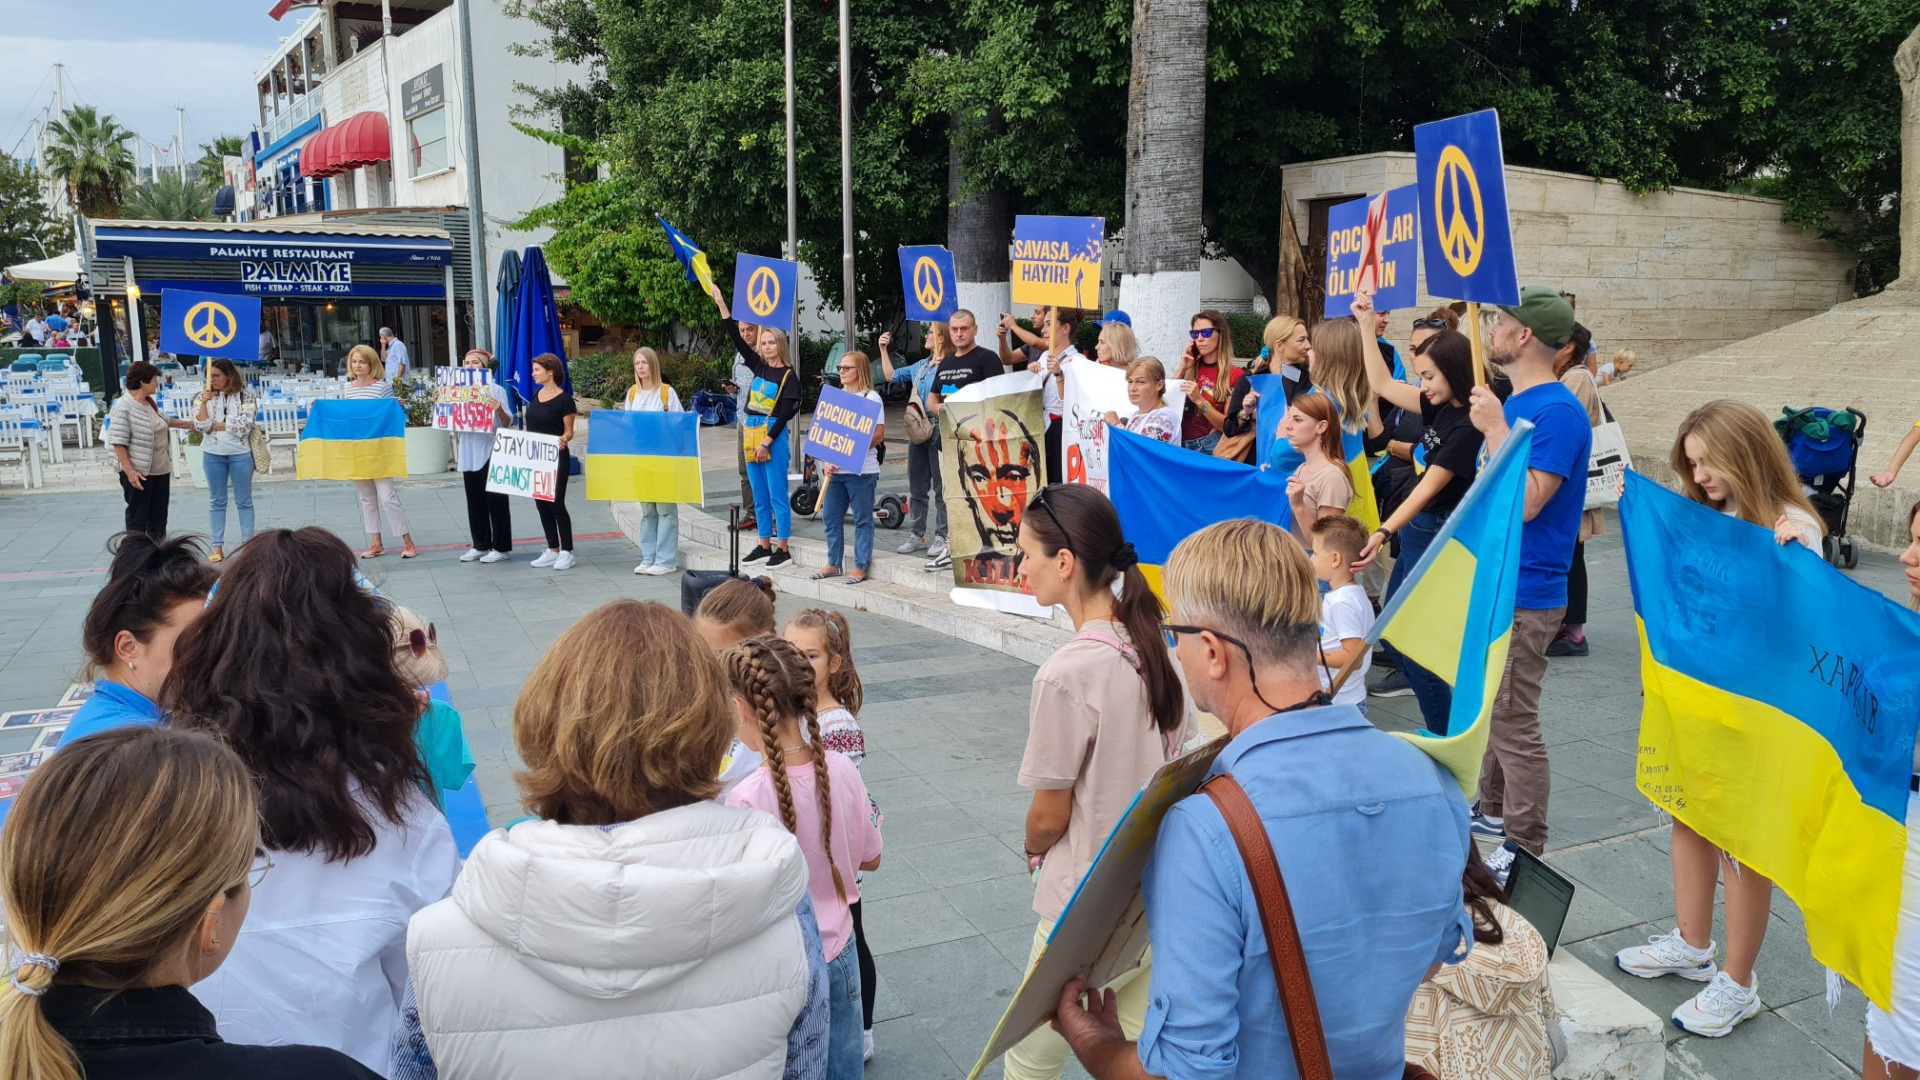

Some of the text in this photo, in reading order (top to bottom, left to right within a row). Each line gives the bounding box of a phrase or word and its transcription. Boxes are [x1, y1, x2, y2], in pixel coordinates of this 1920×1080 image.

[1330, 213, 1413, 262] ÇOCLAR
[210, 246, 354, 259] PALMİYE RESTAURANT
[268, 284, 293, 292] KEBAP
[300, 284, 322, 292] STEAK
[1022, 263, 1069, 284] HAYIR!
[1328, 256, 1395, 296] ÖLMİN
[435, 366, 489, 387] BOYCOTT
[452, 402, 494, 432] RUSSIA
[816, 400, 874, 435] ÇOCUKLAR
[493, 433, 559, 462] STAY UNITED
[808, 422, 855, 457] ÖLMESİN
[488, 464, 532, 491] AGAINST
